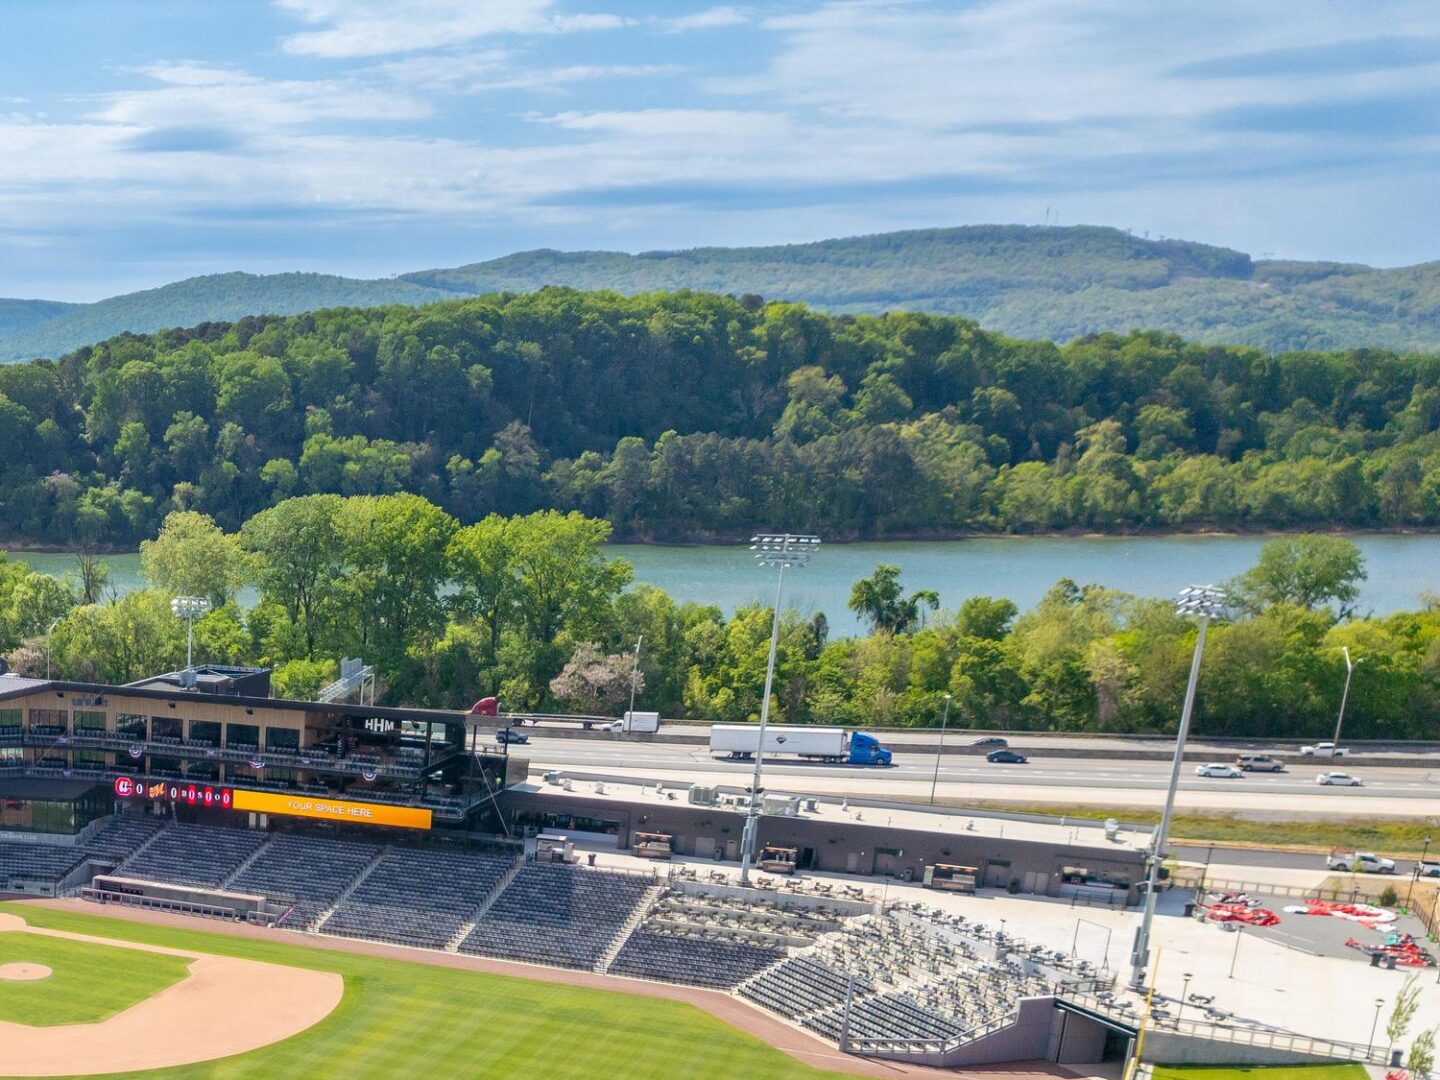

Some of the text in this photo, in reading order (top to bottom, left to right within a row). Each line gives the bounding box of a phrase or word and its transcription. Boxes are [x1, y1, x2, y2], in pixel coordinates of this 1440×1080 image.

[365, 718, 394, 732] HHM
[288, 802, 372, 818] YOUR SPACE HERE
